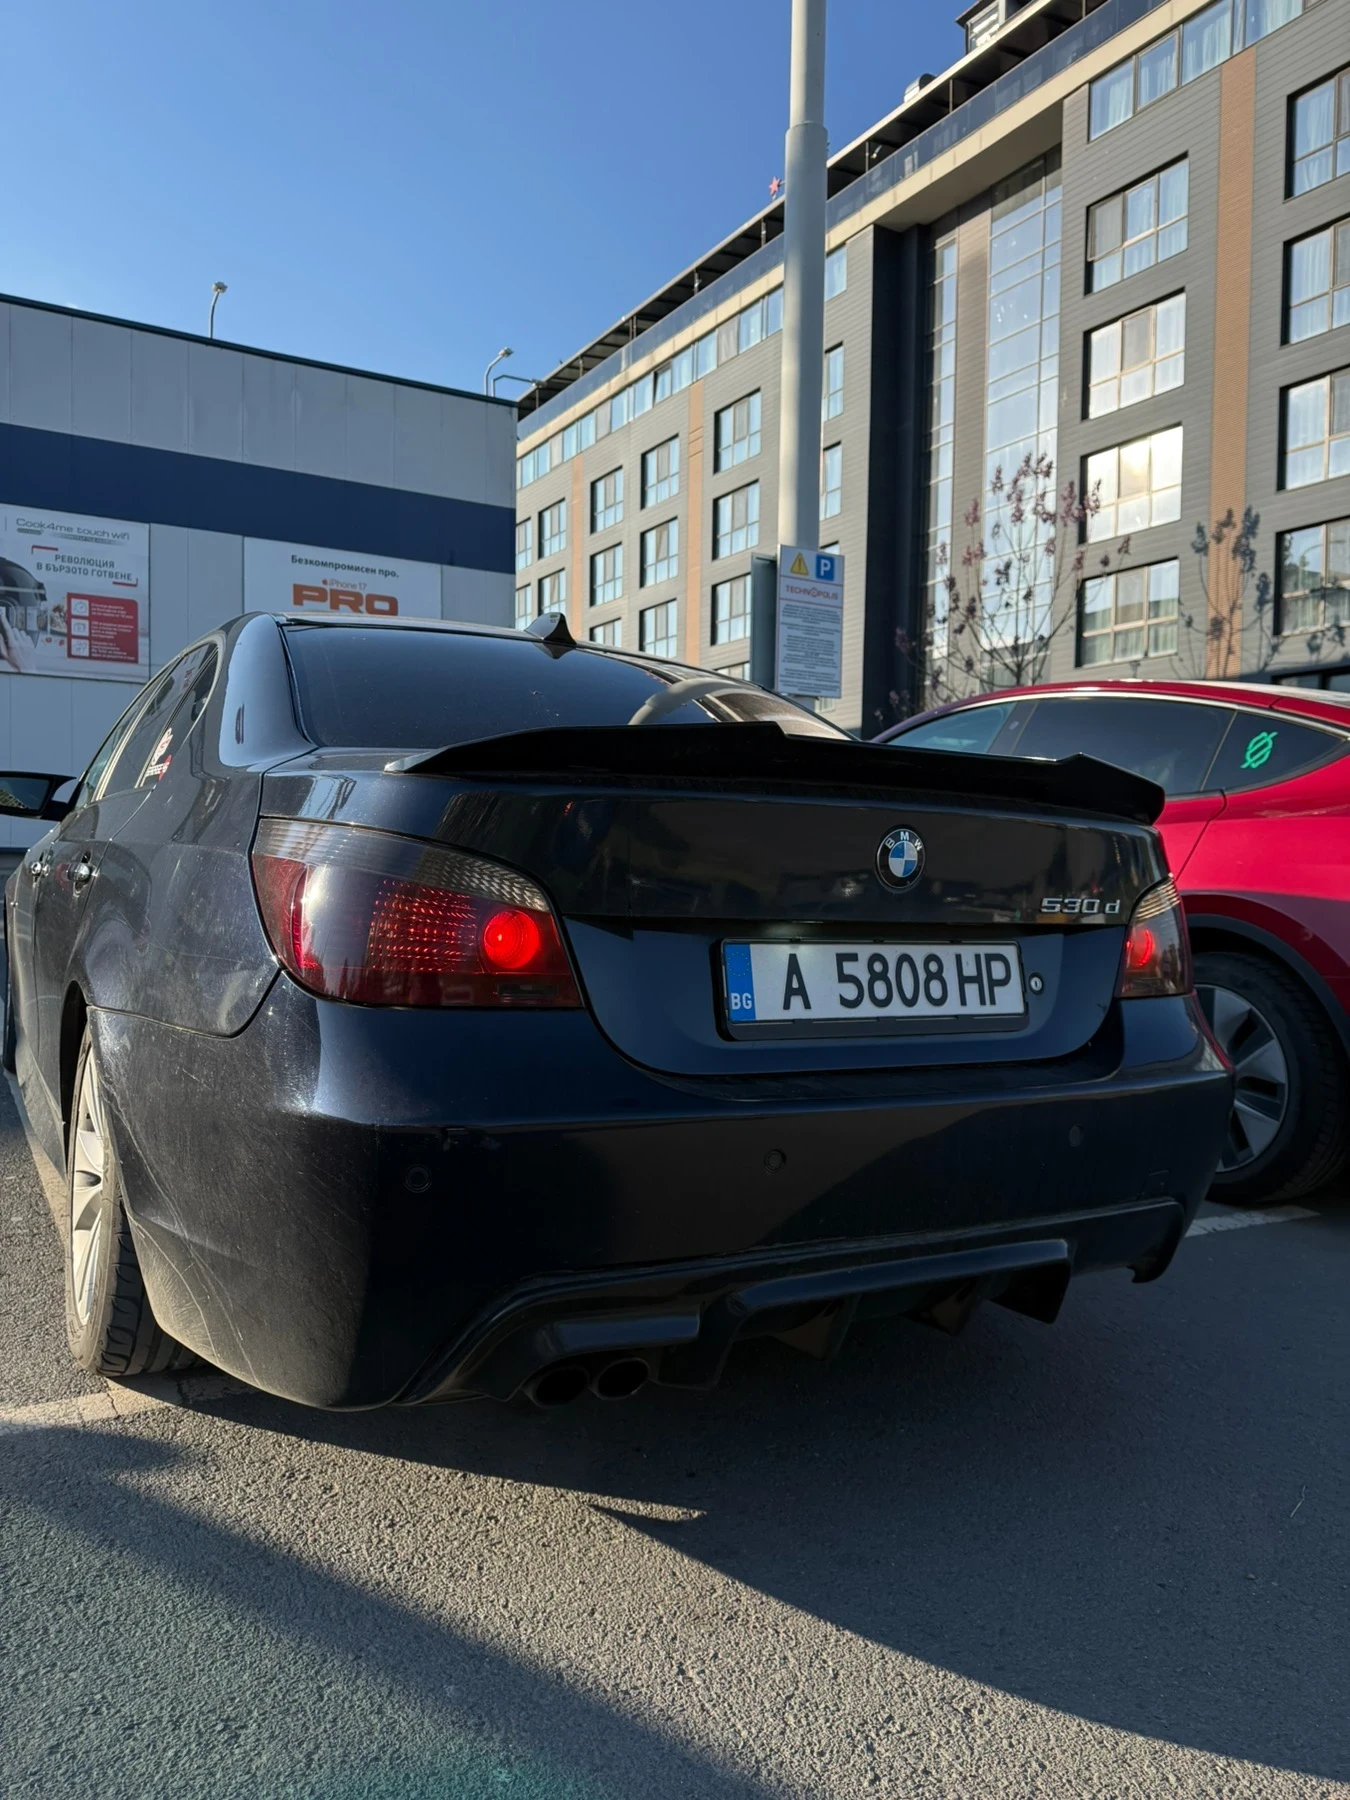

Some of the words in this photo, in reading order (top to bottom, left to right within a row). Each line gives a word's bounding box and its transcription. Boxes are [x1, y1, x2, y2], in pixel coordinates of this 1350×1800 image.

[16, 517, 73, 533] Cook4me
[77, 527, 109, 538] touch
[54, 554, 115, 569] РЕВОЛЮЦИЯ
[291, 554, 376, 575] Безкомпромисен
[820, 558, 831, 576] P
[36, 562, 43, 570] В
[45, 563, 89, 576] БЪРЗОТО
[91, 569, 133, 581] ГОТВЕНЕ
[329, 578, 357, 590] iPhone
[359, 583, 367, 591] 17
[785, 585, 838, 600] TECHNOPOLIS
[293, 583, 399, 616] PRO
[885, 831, 922, 850] BMW
[782, 953, 812, 1011] A
[730, 992, 753, 1010] BG
